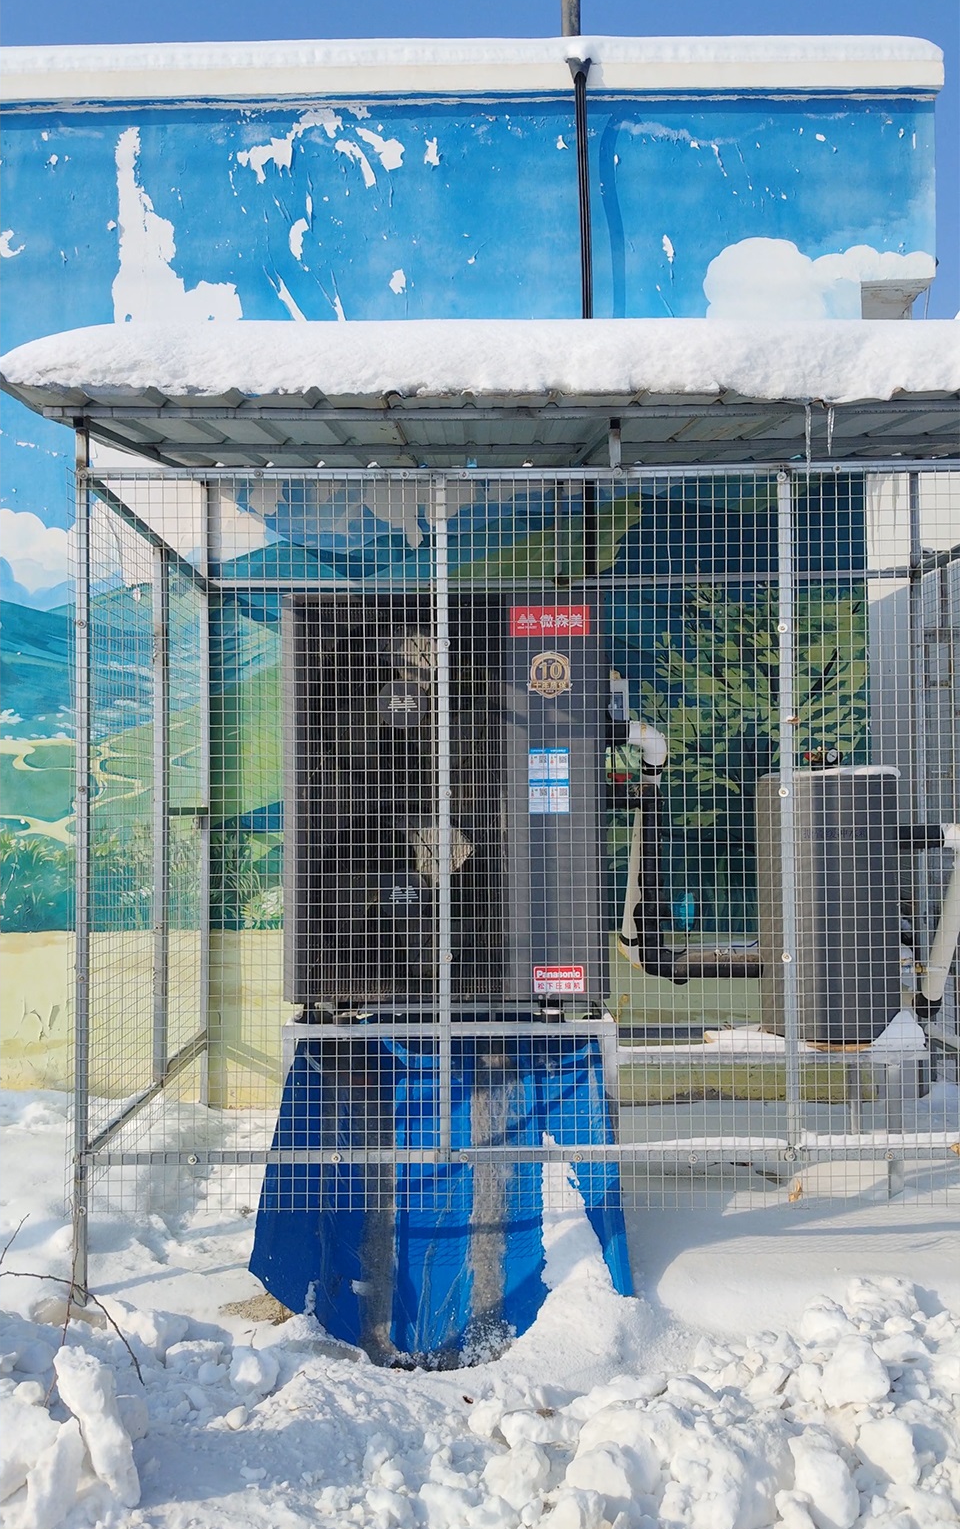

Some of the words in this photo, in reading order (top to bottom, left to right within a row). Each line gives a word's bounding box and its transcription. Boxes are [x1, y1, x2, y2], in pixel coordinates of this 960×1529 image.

[540, 613, 584, 628] 微森美
[539, 662, 562, 679] 10
[536, 969, 581, 979] Panasonic
